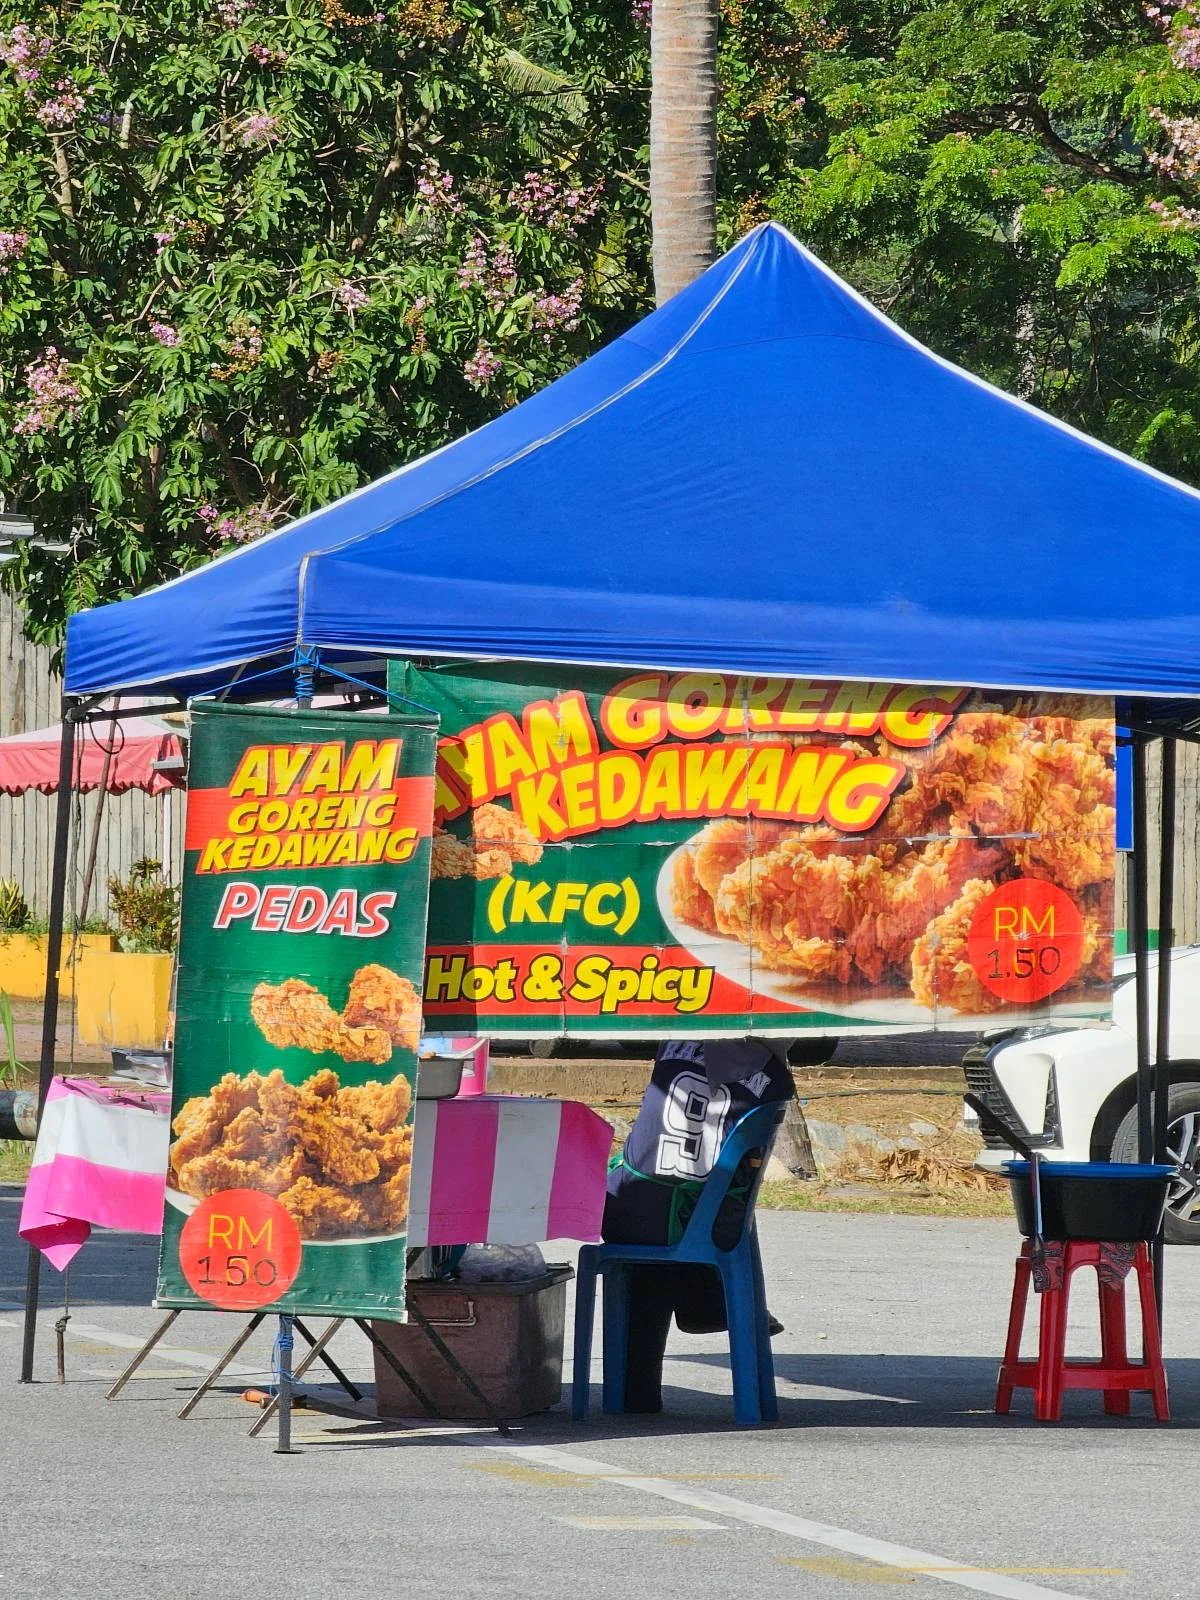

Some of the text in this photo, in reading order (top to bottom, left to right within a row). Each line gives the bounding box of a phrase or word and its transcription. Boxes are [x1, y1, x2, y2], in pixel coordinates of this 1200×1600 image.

[229, 740, 402, 799] AYAM
[434, 670, 961, 815] YAM GORENG
[227, 793, 399, 836] GORENG
[515, 745, 902, 840] KEDAWANG
[199, 827, 419, 873] KEDAWANG
[213, 881, 397, 938] PEDAS
[487, 875, 641, 936] (KFC)
[994, 905, 1056, 942] RM
[423, 953, 716, 1013] Hot & Spicy
[987, 946, 1061, 978] 1.50
[208, 1214, 273, 1252] RM
